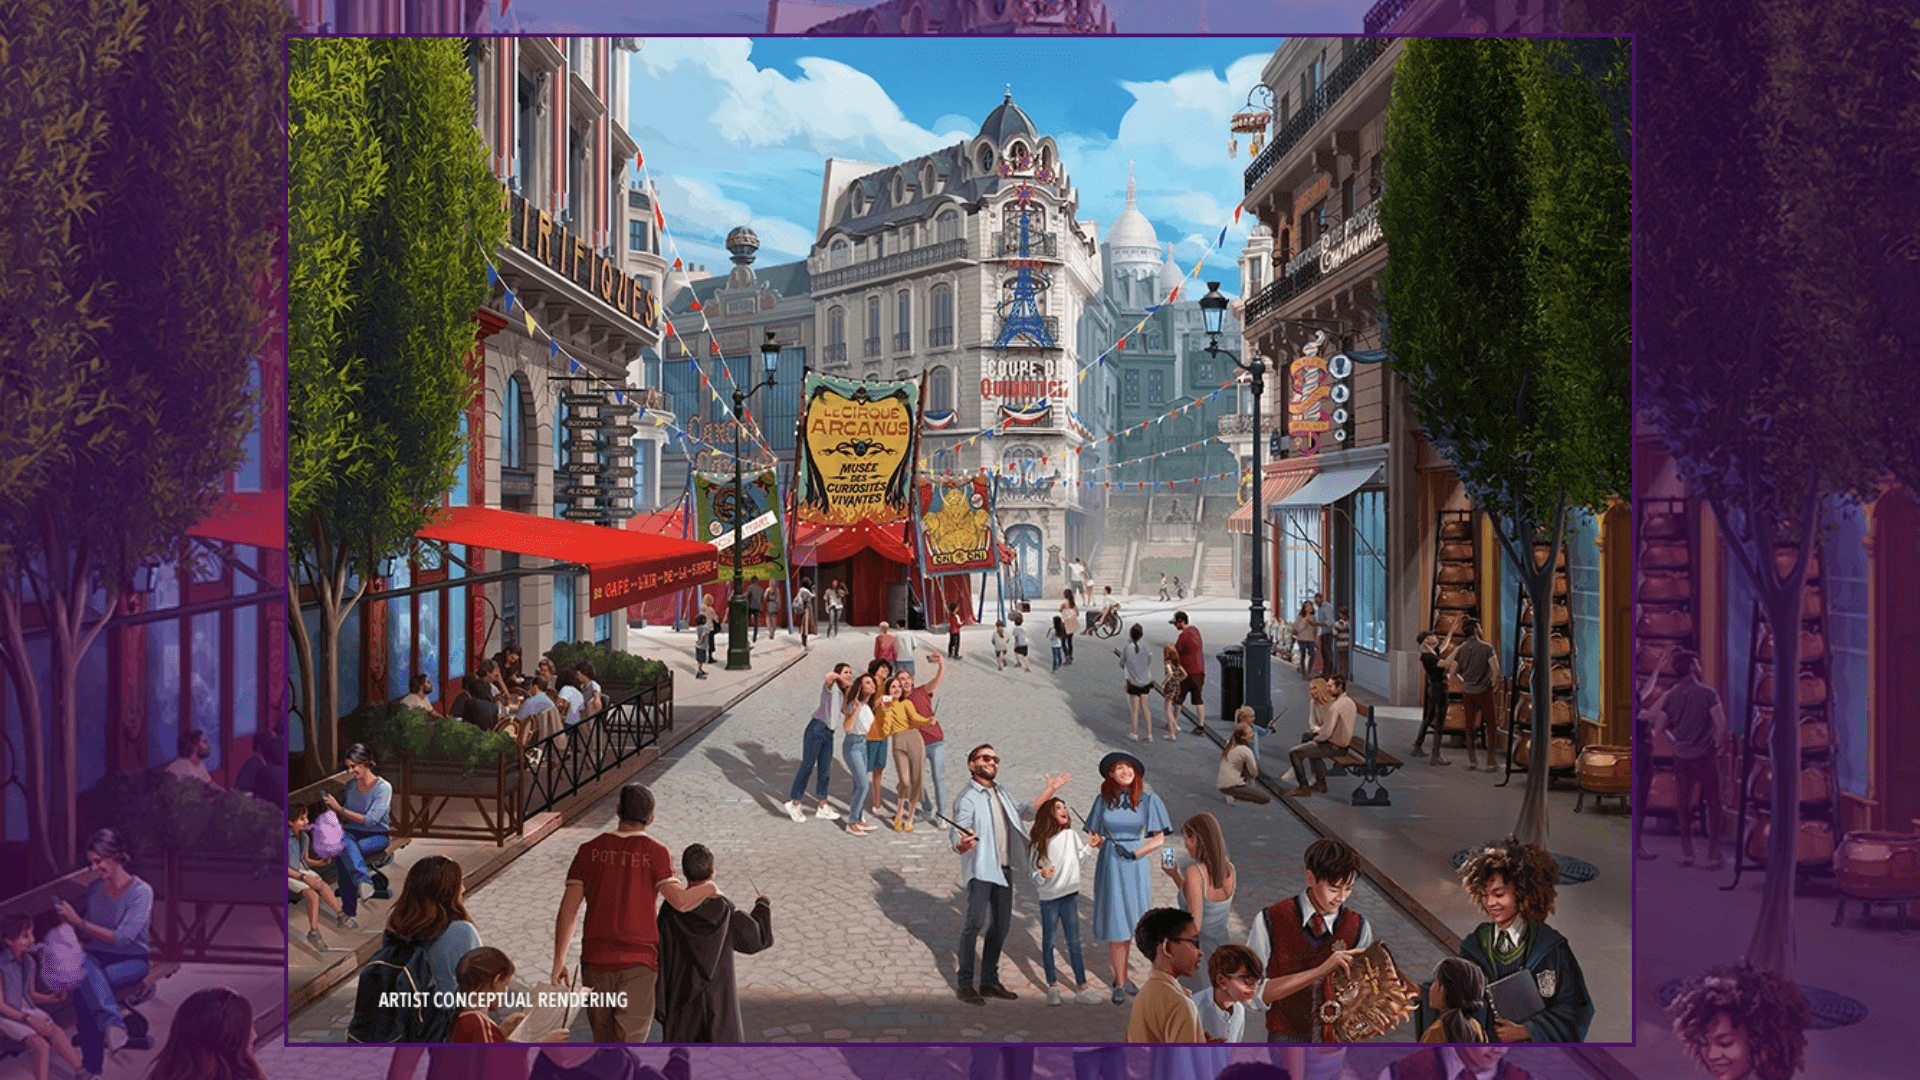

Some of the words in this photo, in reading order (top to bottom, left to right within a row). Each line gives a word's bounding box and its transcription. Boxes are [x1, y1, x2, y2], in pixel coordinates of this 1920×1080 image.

[987, 359, 1039, 378] COUPE
[824, 409, 840, 419] LE
[841, 406, 900, 420] CIRQUE
[811, 419, 908, 436] ARCANUS
[840, 461, 878, 475] MUSÉE
[831, 493, 882, 507] VIVANTES
[605, 577, 629, 598] CAFÉ
[591, 848, 651, 868] POTTER
